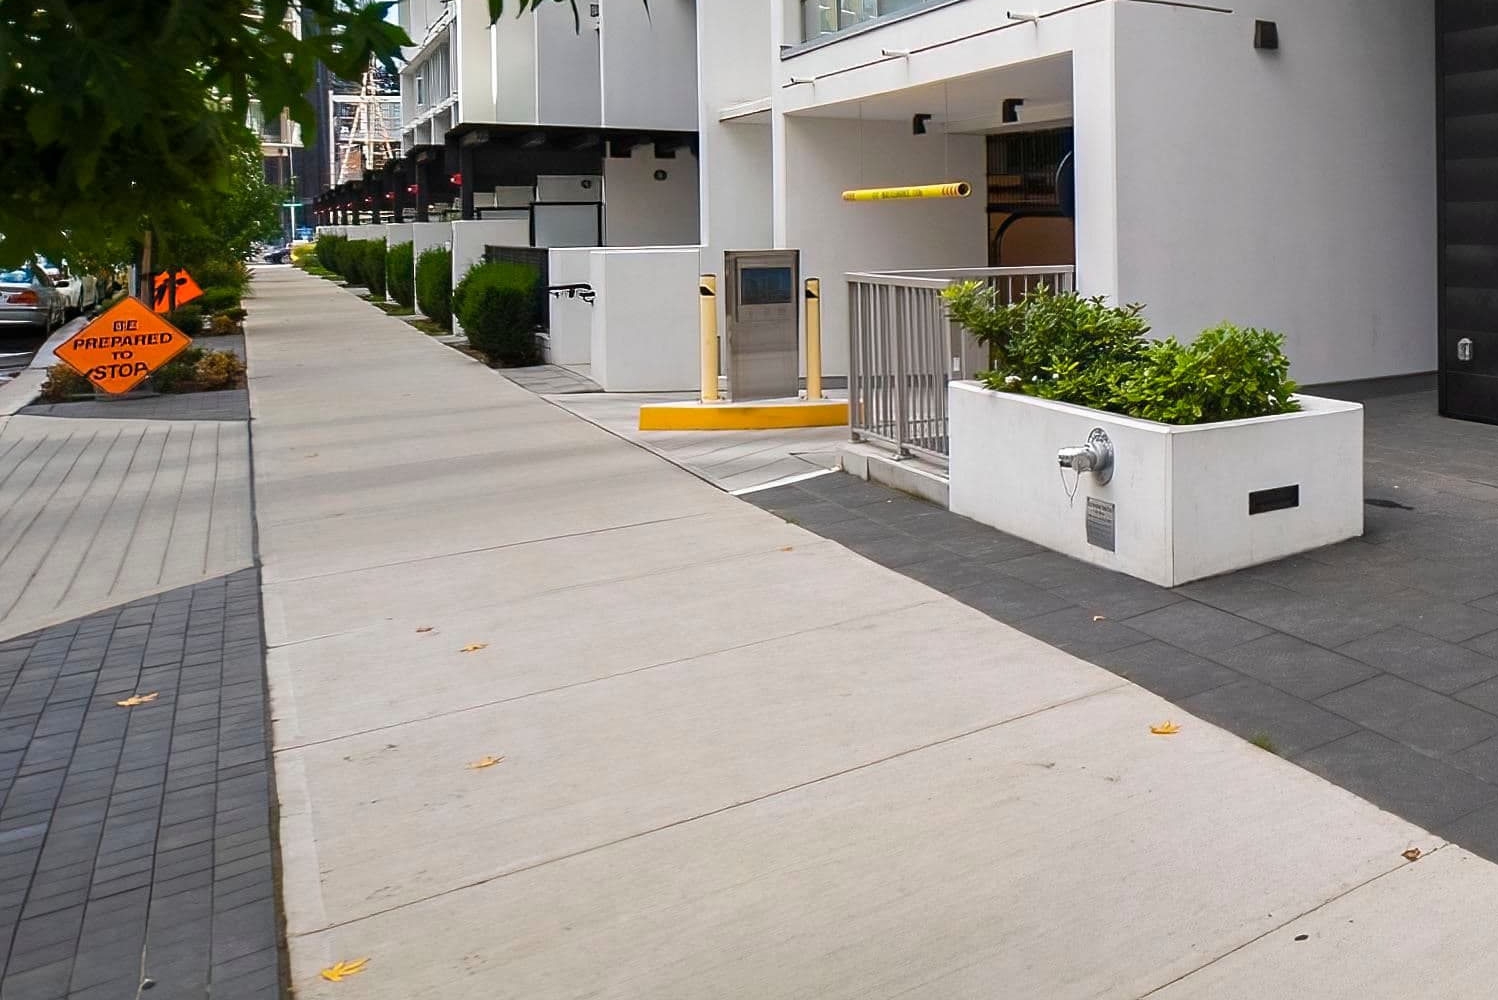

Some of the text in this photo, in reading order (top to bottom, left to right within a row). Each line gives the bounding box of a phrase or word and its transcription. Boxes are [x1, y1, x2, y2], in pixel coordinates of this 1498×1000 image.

[113, 320, 138, 332] BE
[73, 333, 173, 350] PREPARED
[111, 350, 133, 360] TO
[93, 362, 148, 380] STOP
